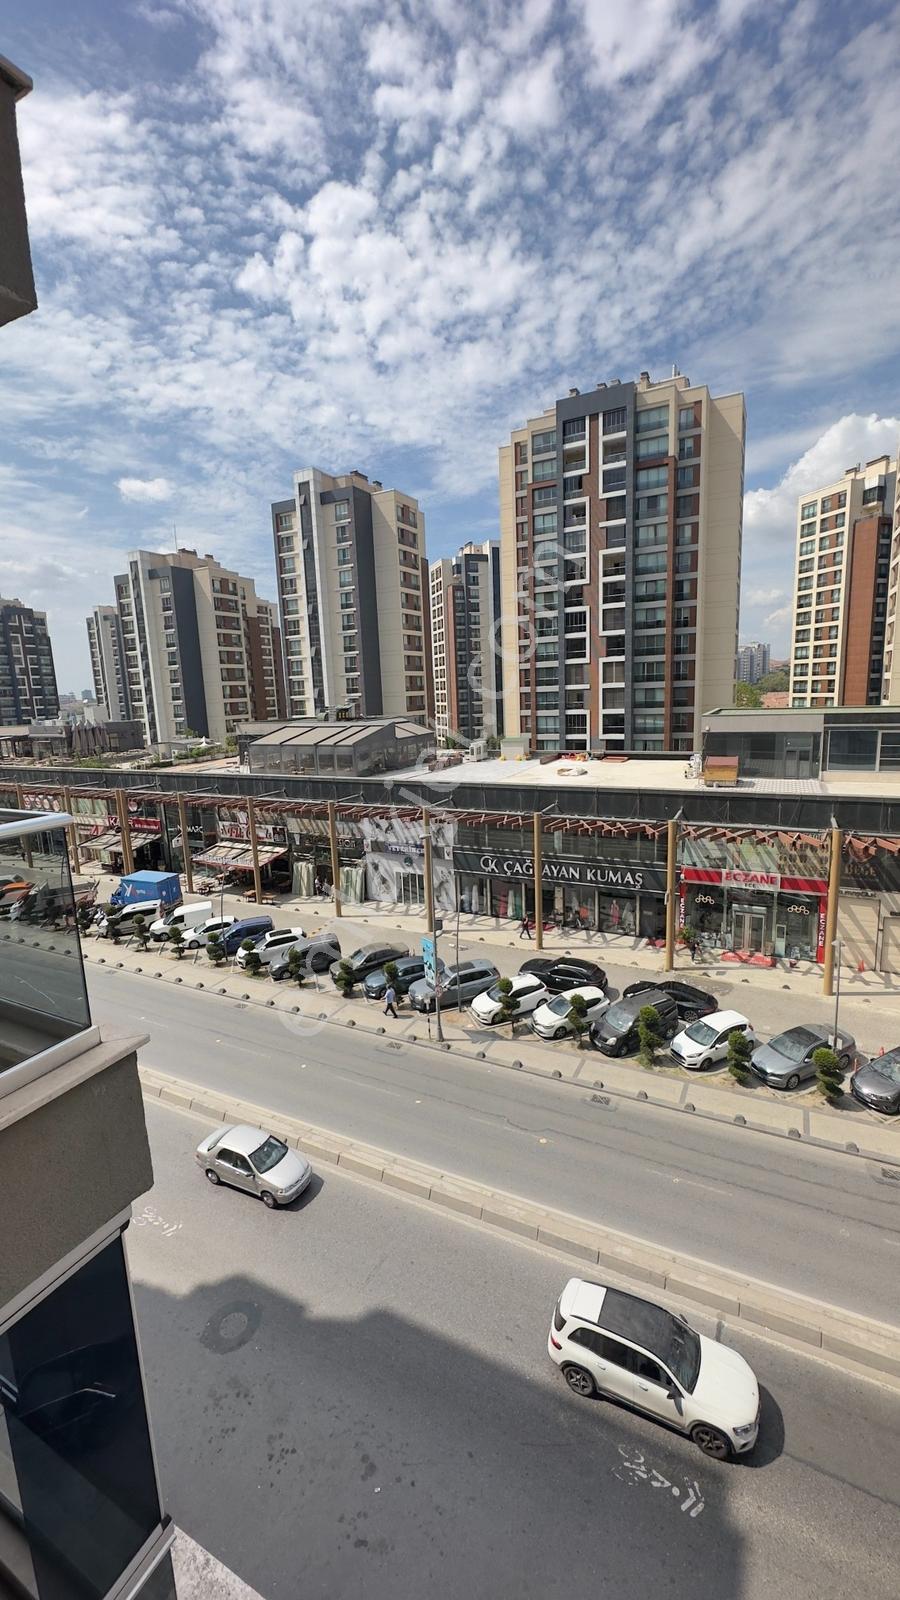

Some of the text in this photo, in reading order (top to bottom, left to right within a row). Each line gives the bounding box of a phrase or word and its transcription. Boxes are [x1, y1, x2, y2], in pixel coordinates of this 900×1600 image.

[503, 859, 580, 881] ÇAĞAYAN
[587, 868, 643, 889] KUMAŞ
[725, 870, 777, 885] ECZANE
[818, 912, 826, 947] ECZANE
